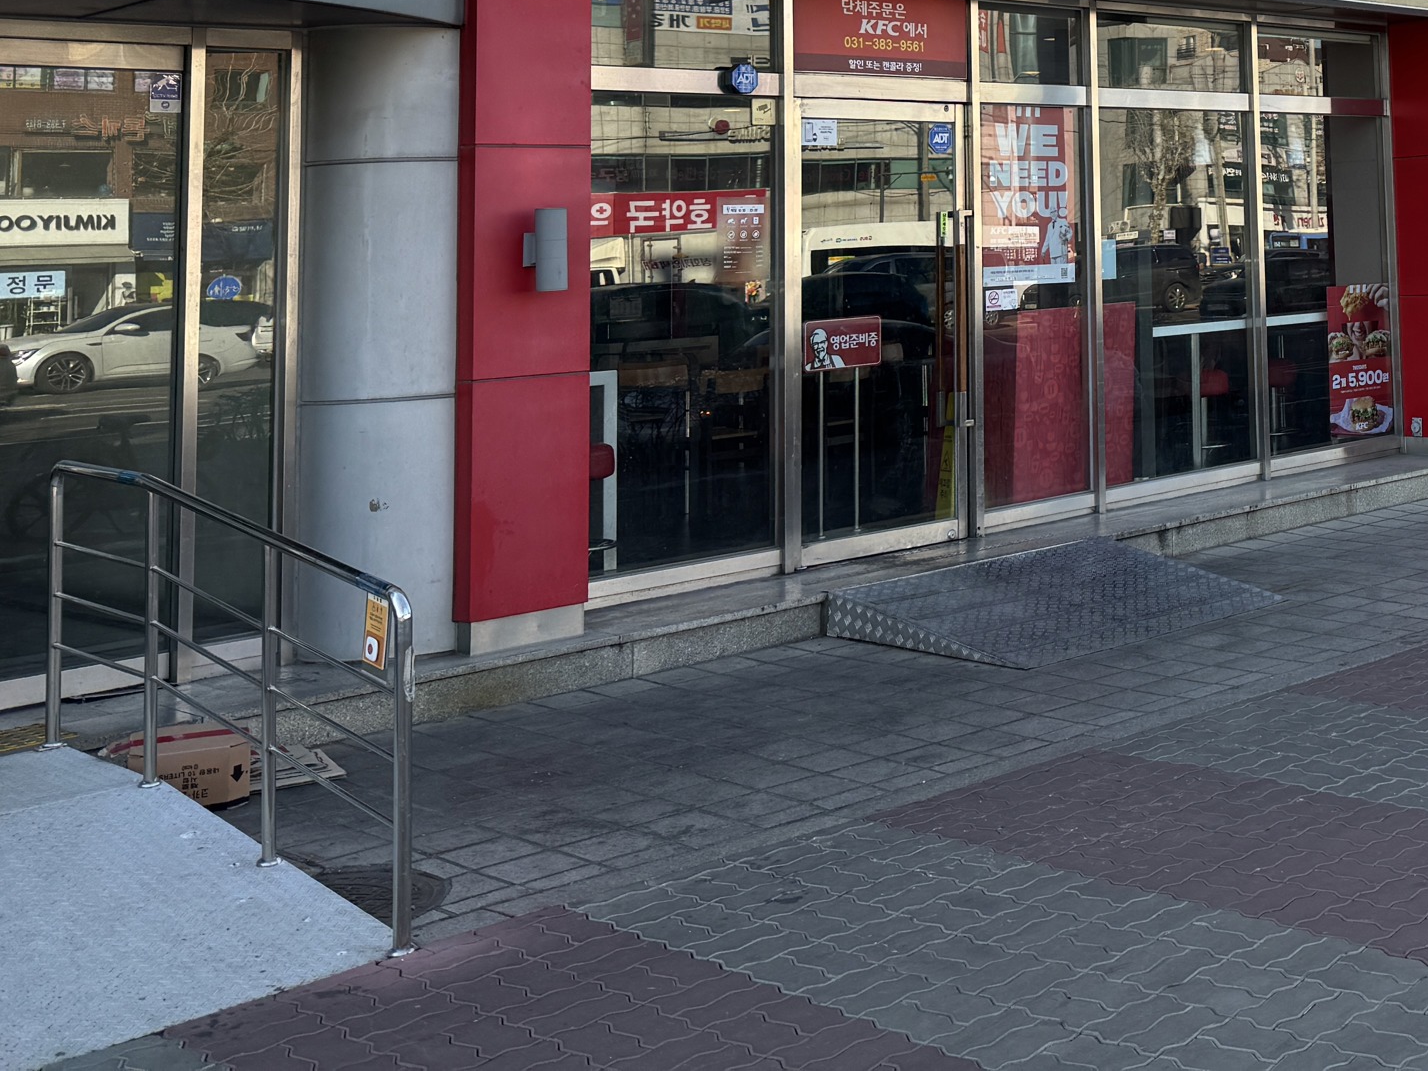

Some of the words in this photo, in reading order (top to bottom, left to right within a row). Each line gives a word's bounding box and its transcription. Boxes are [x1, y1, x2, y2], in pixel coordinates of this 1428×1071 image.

[841, 0, 906, 19] 단체주문은
[859, 18, 901, 36] KFC
[902, 22, 928, 38] 에서
[844, 36, 925, 52] 031-383-9561
[849, 59, 864, 70] 할인
[866, 61, 880, 71] 또는
[737, 73, 754, 84] ADT
[932, 132, 950, 144] ADT
[995, 123, 1059, 157] WE
[990, 160, 1068, 187] NEED
[989, 191, 1069, 218] YOU!
[6, 274, 55, 295] 정문
[830, 332, 878, 351] 영업준비중
